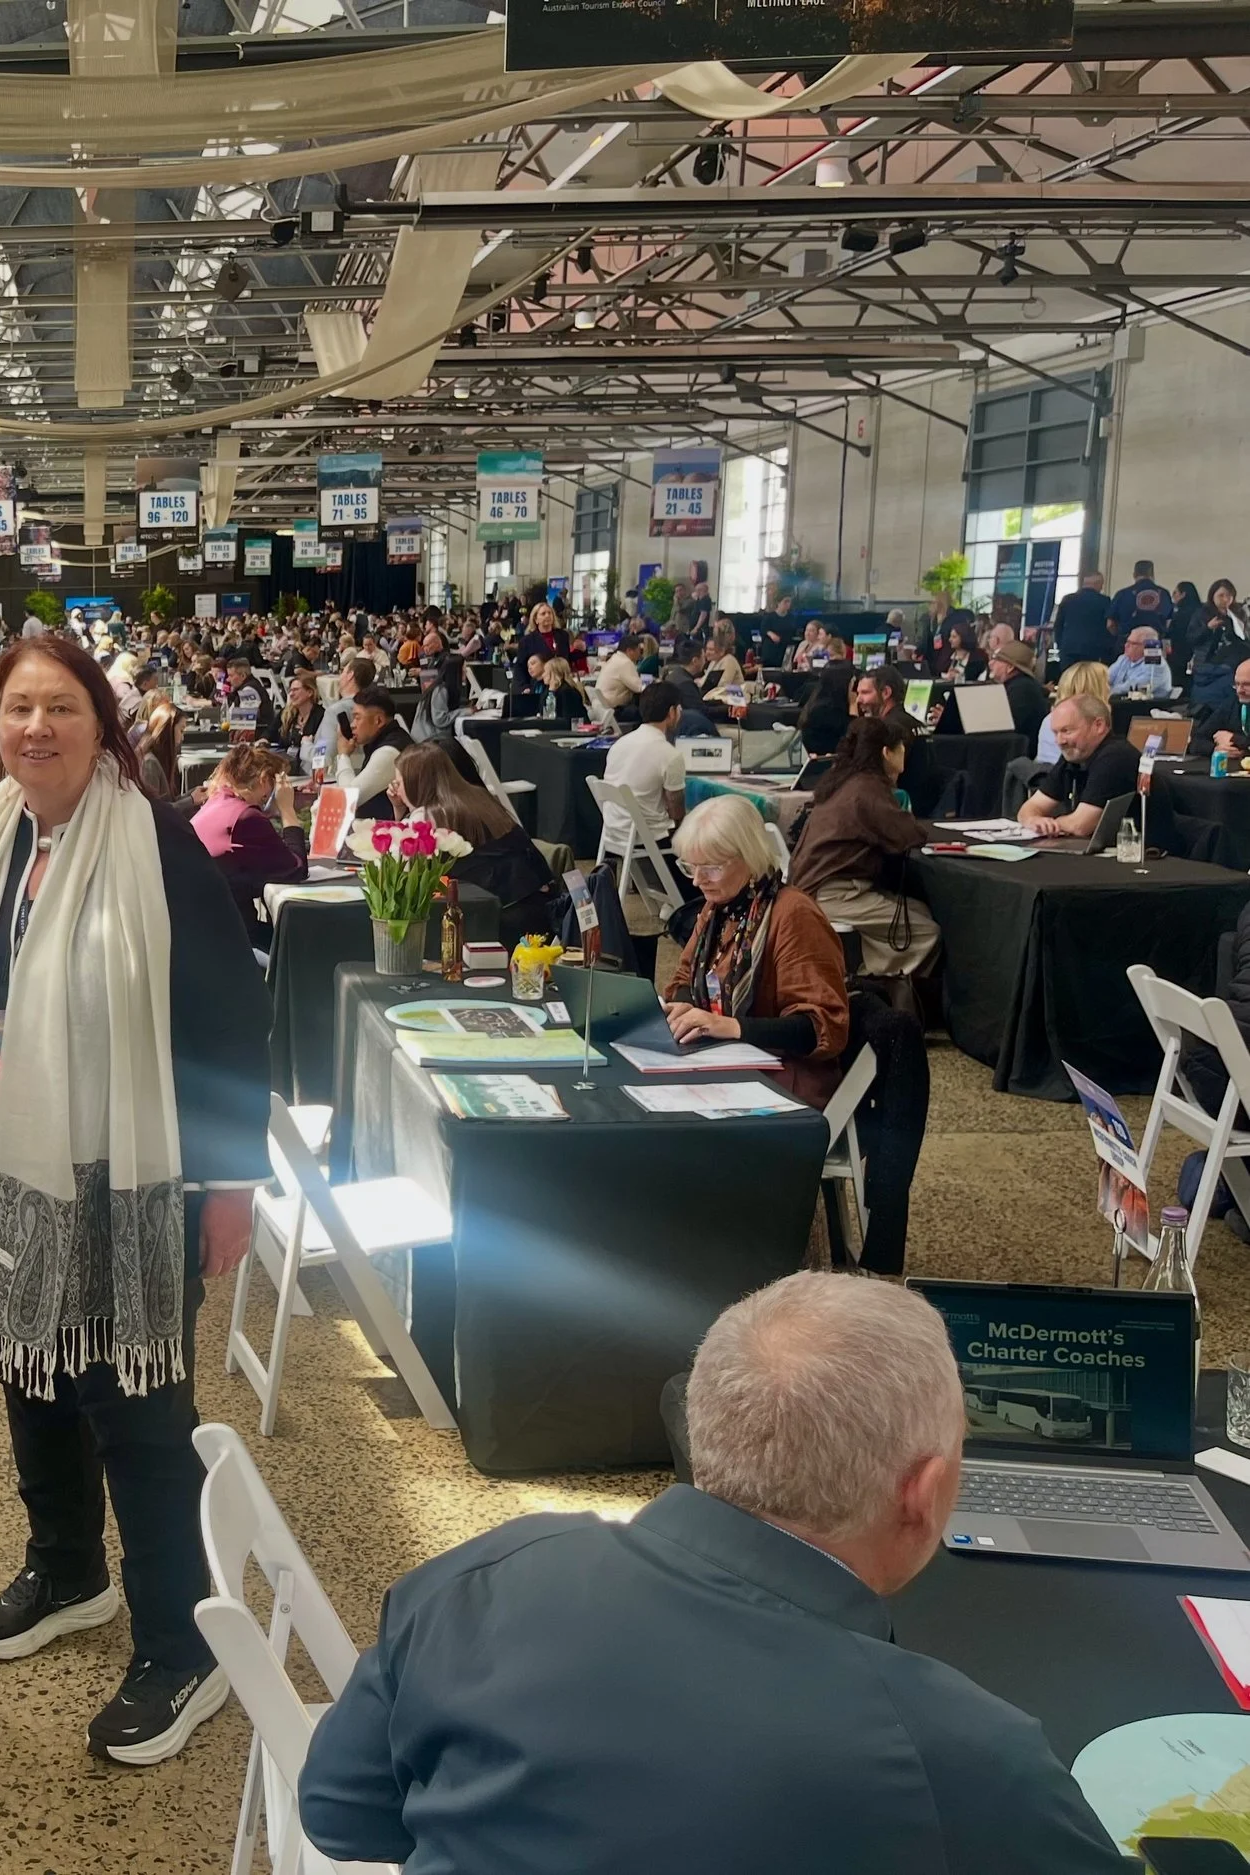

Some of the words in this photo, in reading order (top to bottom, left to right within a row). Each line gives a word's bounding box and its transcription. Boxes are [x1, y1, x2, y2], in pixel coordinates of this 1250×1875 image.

[542, 4, 579, 12] Australian
[581, 2, 610, 10] Tourism
[332, 493, 367, 507] TABLES
[491, 491, 527, 504] TABLES
[666, 487, 703, 500] TABLES
[150, 496, 185, 509] TABLES
[664, 503, 678, 515] 21
[687, 502, 702, 515] 45
[147, 511, 161, 523] 96
[171, 510, 189, 523] 120
[332, 509, 343, 521] 71
[354, 507, 367, 520] 95
[489, 506, 504, 519] 46
[514, 505, 528, 518] 70
[987, 1321, 1126, 1346] McDermott's
[966, 1340, 1048, 1363] Charter
[1052, 1346, 1146, 1368] Coaches
[170, 1674, 199, 1715] HOKA
